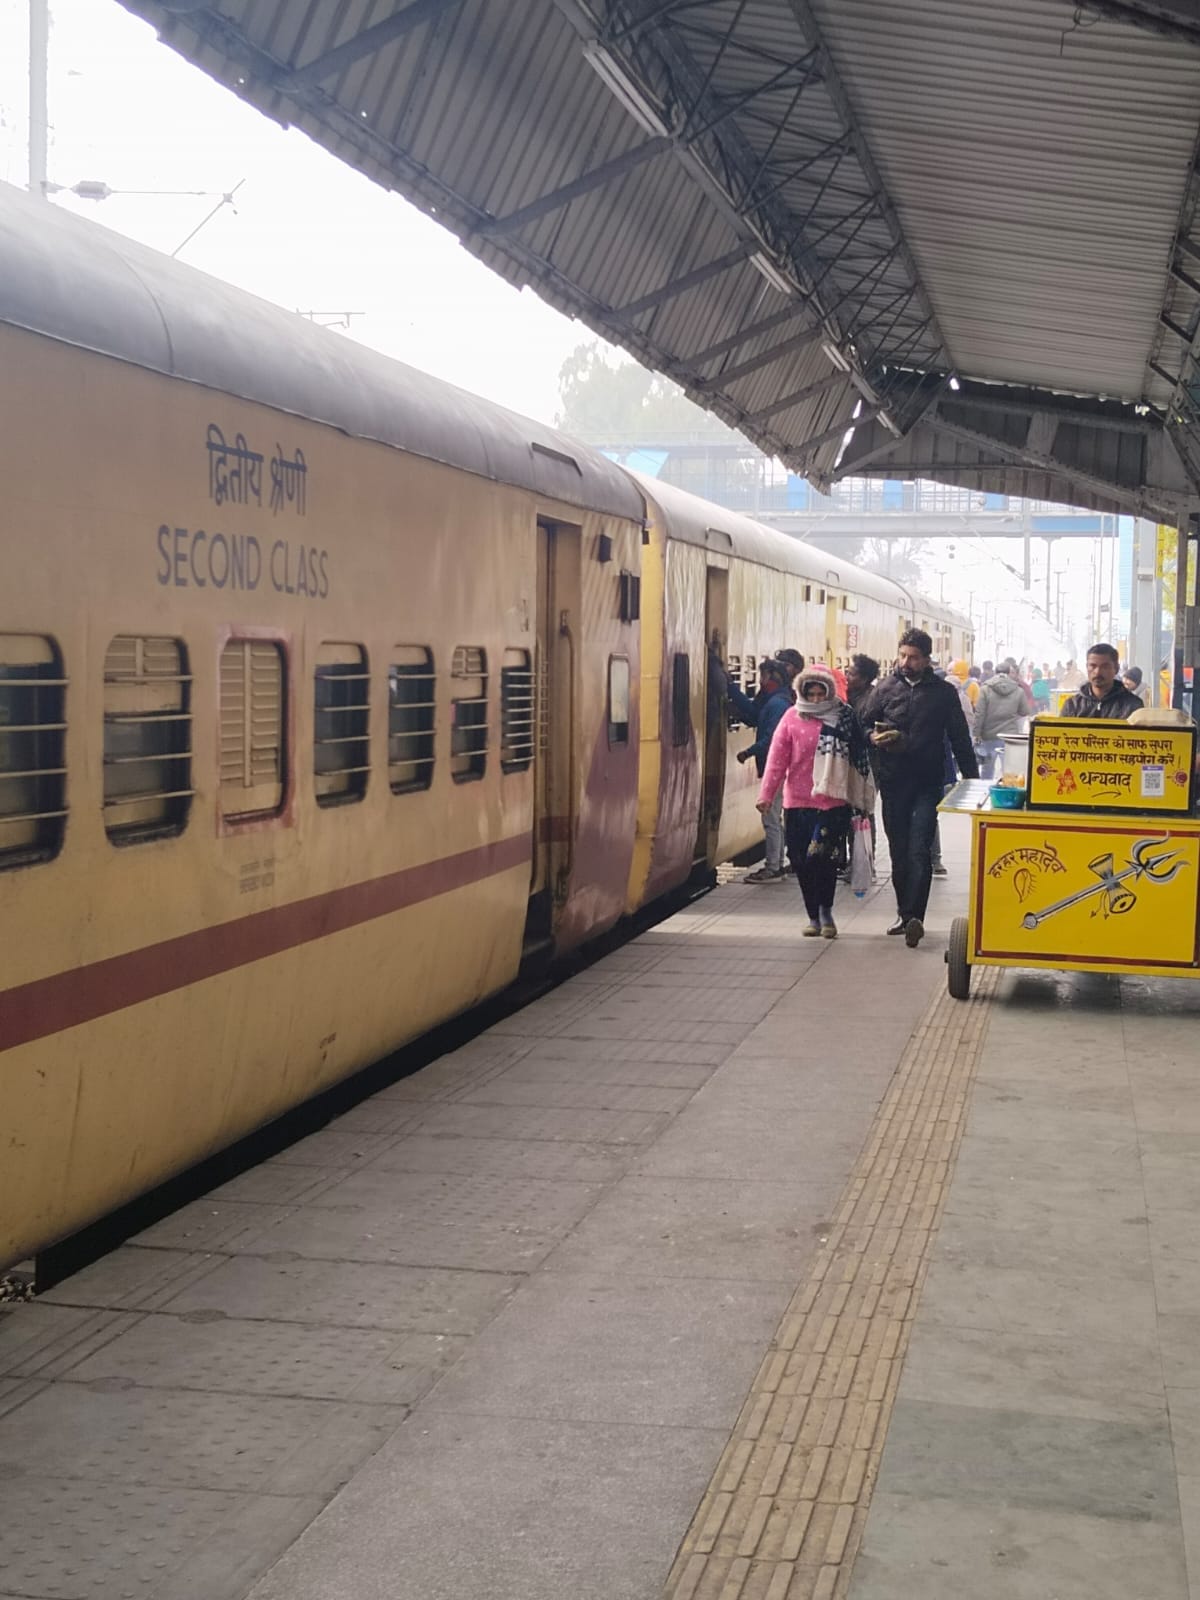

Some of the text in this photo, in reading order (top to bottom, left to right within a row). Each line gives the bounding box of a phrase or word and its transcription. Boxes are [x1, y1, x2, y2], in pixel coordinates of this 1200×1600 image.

[206, 423, 307, 517] द्वितीय श्रेणी
[157, 524, 329, 599] SECOND CLASS
[1063, 732, 1080, 749] रेल
[1081, 733, 1110, 749] परिसर
[1112, 735, 1125, 749] को
[1126, 739, 1148, 750] साफ
[1069, 751, 1103, 763] प्रशासन
[1103, 752, 1118, 763] का
[1119, 751, 1155, 766] सहयोग
[1079, 771, 1132, 792] धन्यवाद
[1015, 840, 1067, 873] महादेव
